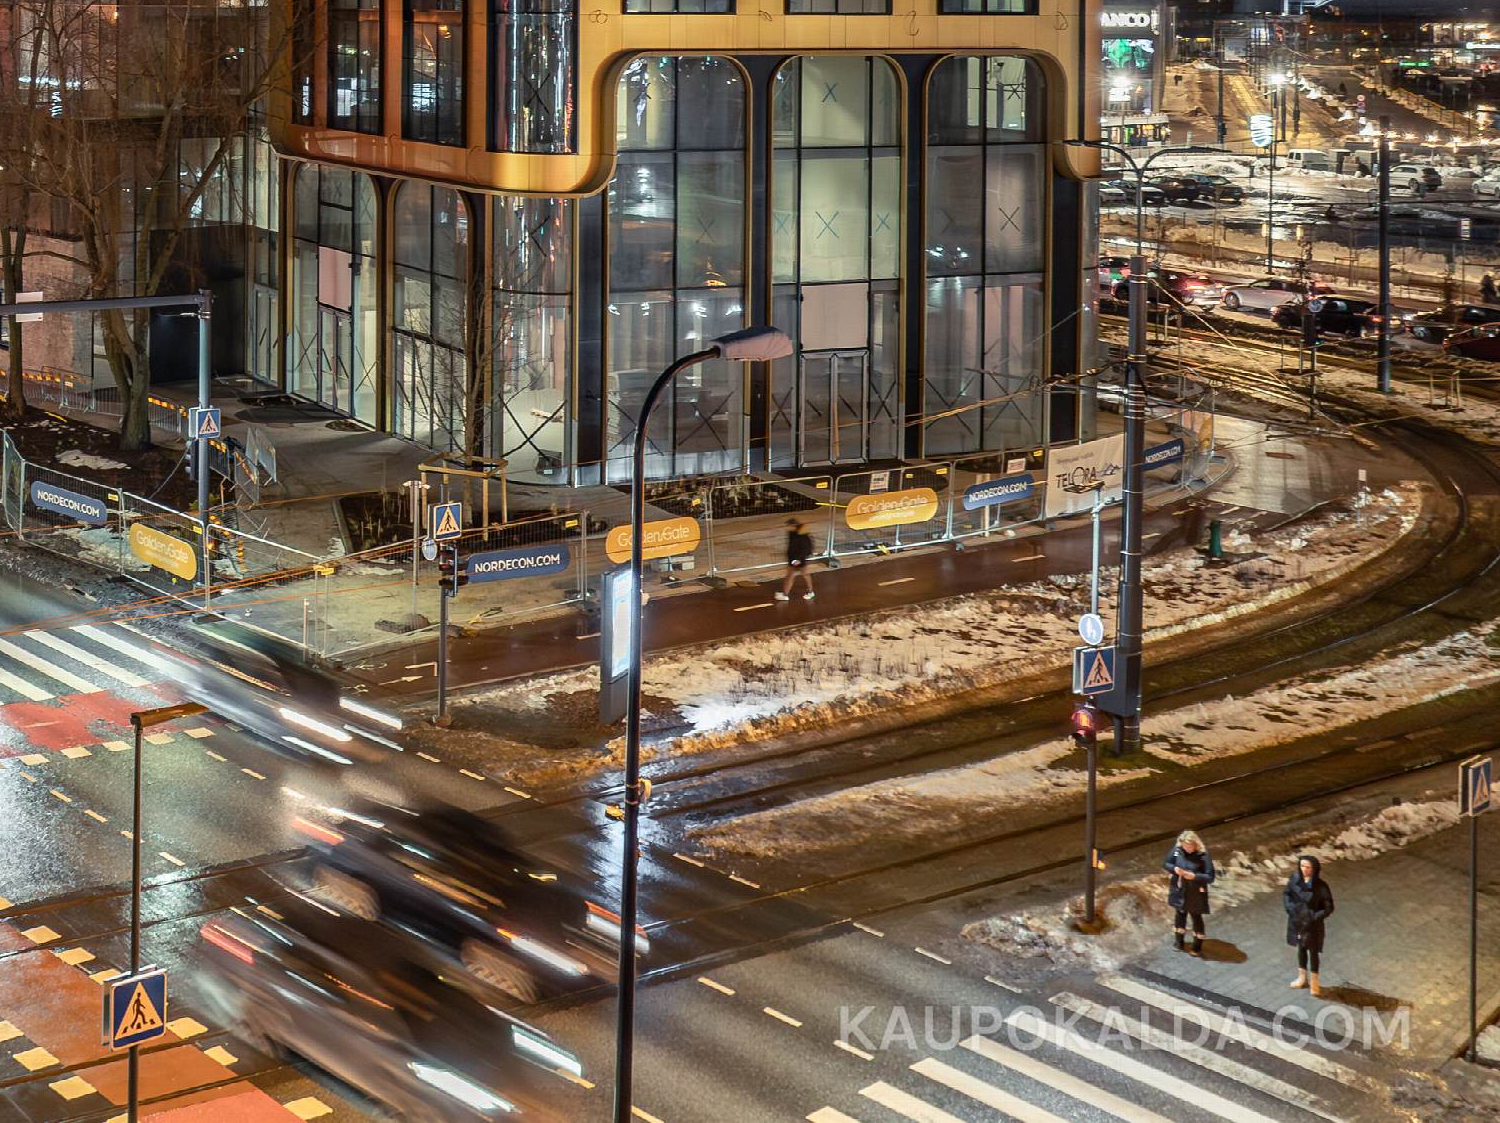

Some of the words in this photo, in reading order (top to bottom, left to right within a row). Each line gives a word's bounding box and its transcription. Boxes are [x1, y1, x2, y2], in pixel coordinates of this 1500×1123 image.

[968, 482, 1028, 502] NORDECON.COM
[37, 490, 100, 517] NORDECON.COM
[474, 553, 561, 573] NORDECON.COM
